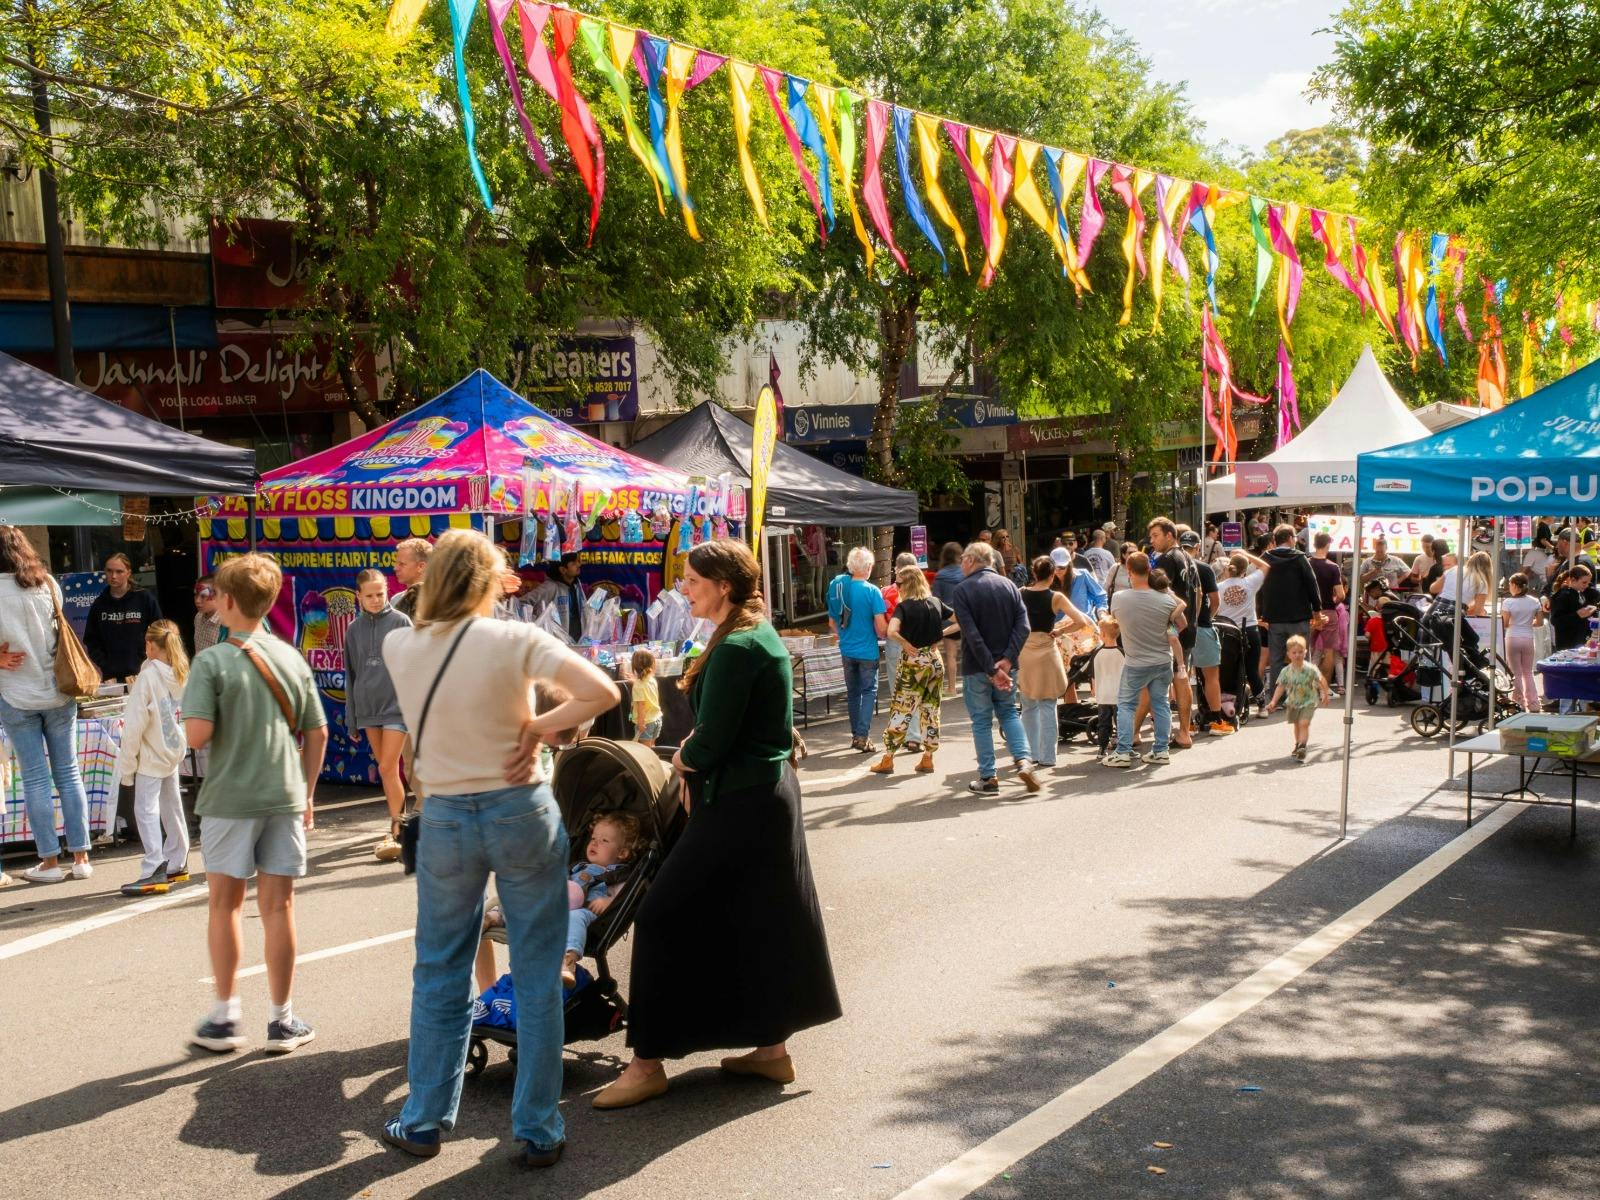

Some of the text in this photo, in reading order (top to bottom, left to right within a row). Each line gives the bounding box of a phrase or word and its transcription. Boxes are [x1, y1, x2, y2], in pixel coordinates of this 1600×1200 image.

[74, 350, 208, 393] Jannali
[615, 381, 631, 392] 7017
[160, 397, 188, 408] YOUR
[191, 396, 223, 407] LOCAL
[324, 392, 343, 402] OPEN
[811, 413, 850, 430] Vinnies
[350, 456, 423, 467] KINGDOM
[1309, 474, 1356, 484] FACE PA
[1470, 475, 1598, 502] POP-U
[224, 486, 457, 512] FARY FLOSS KINGDOM
[642, 491, 724, 517] KINGOM
[1362, 521, 1422, 535] ACE
[283, 551, 333, 568] SUPREME
[335, 551, 368, 568] FAIRY
[370, 551, 398, 567] FLOS
[602, 551, 631, 565] FAIRY
